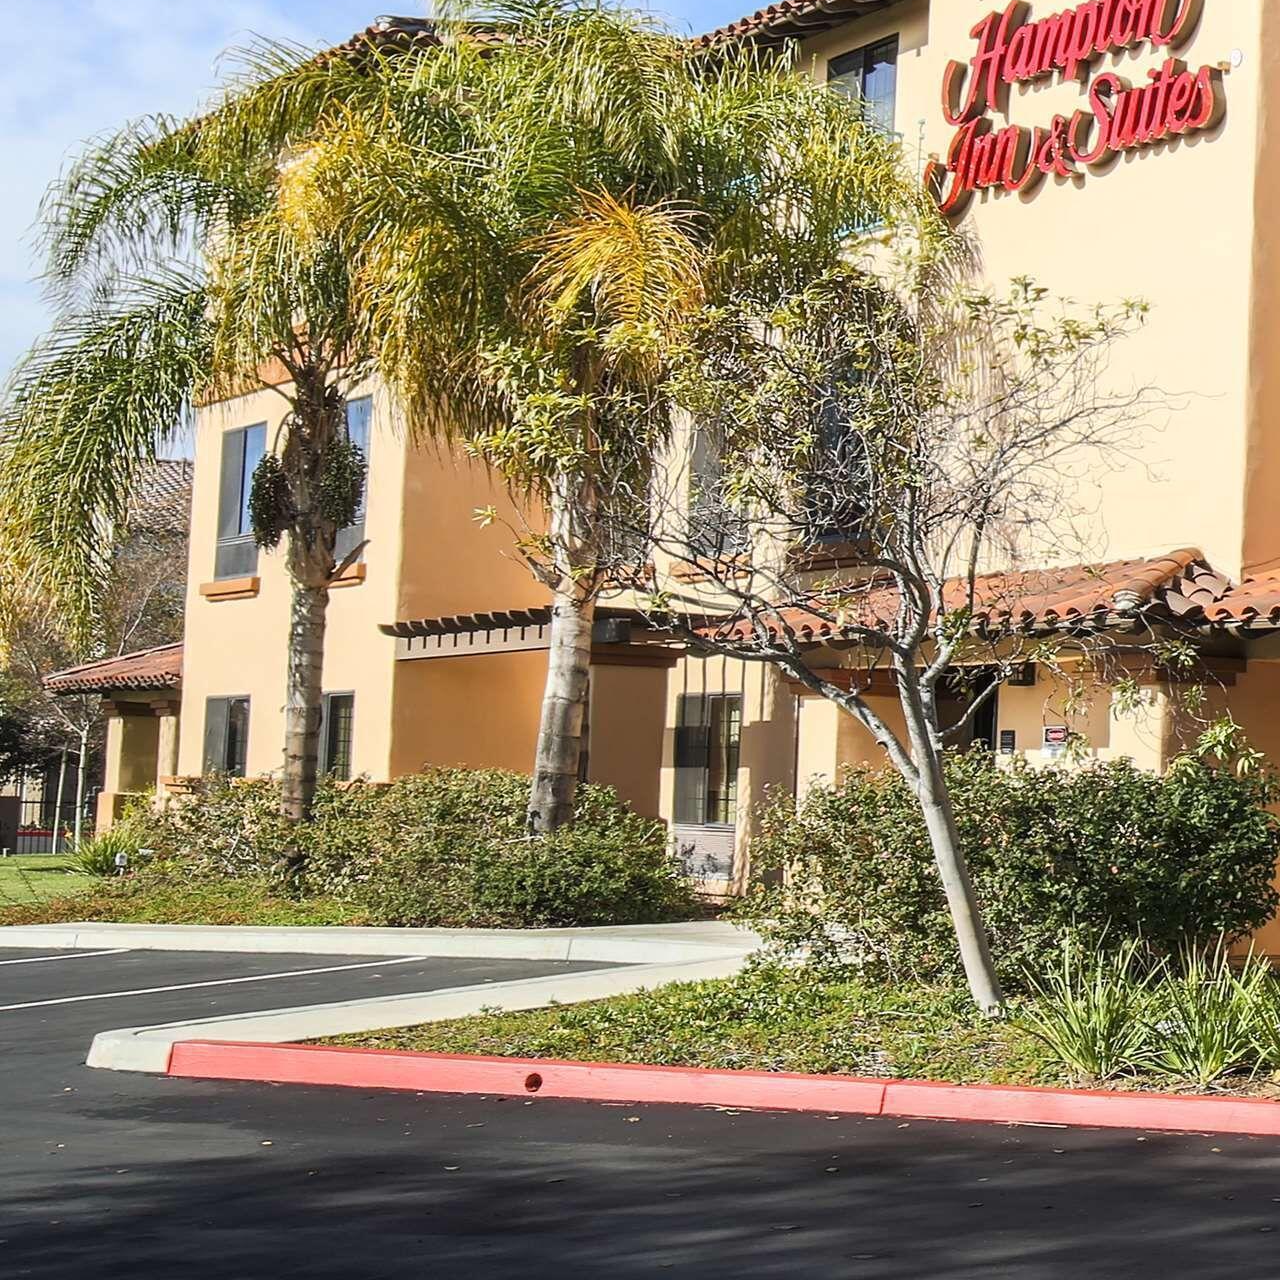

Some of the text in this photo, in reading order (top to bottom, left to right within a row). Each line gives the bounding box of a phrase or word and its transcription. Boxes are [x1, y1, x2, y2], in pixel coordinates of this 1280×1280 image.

[924, 57, 1215, 214] Inn & Suites
